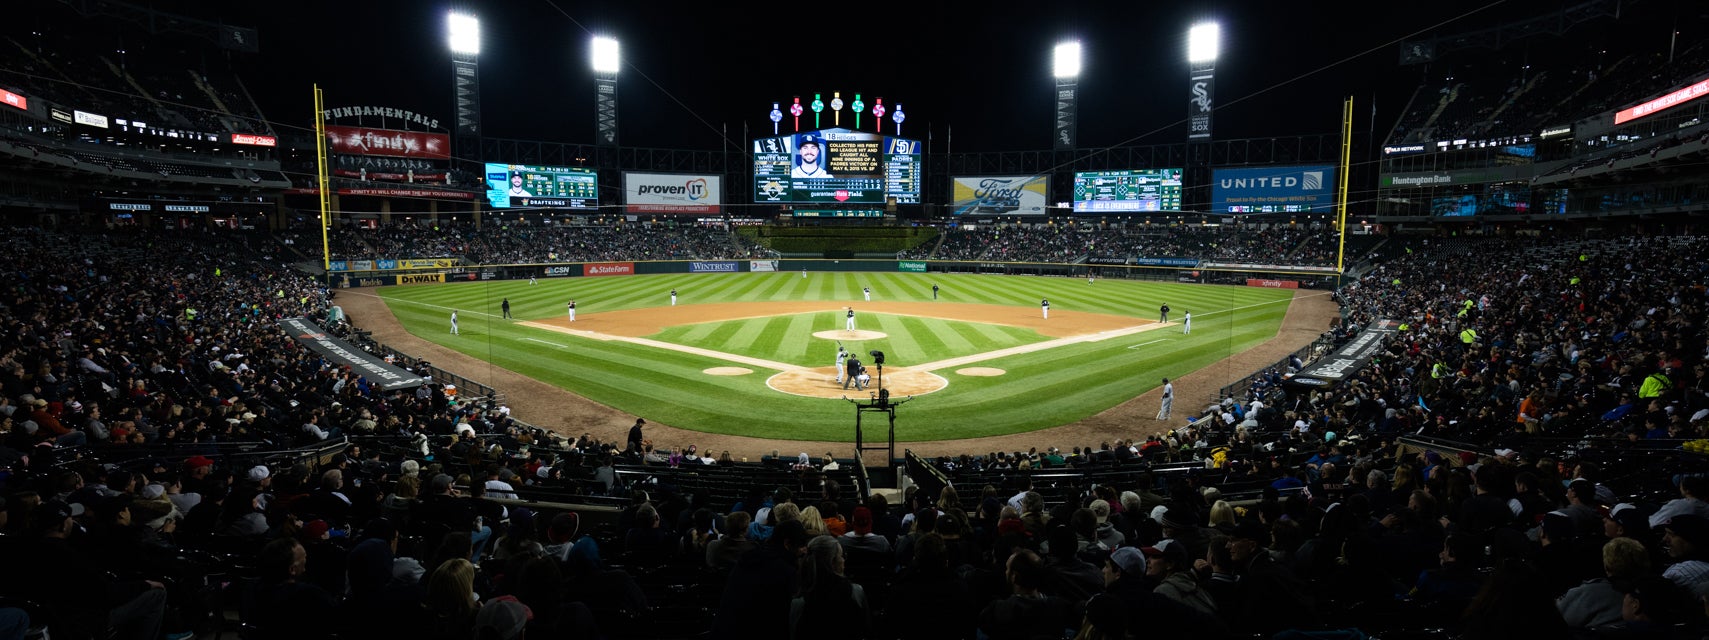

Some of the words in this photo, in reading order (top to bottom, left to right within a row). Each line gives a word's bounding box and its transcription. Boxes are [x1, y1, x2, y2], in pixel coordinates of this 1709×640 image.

[324, 106, 439, 129] FUNDAMENTALS
[1192, 124, 1208, 132] SOX
[234, 134, 275, 146] Jewel-Osco
[1221, 177, 1297, 189] UNITED
[1392, 177, 1432, 185] Huntington
[1434, 175, 1451, 183] Bank
[638, 184, 686, 196] proven
[691, 184, 703, 195] IT
[975, 179, 1023, 199] Ford
[1262, 280, 1282, 288] xfinity
